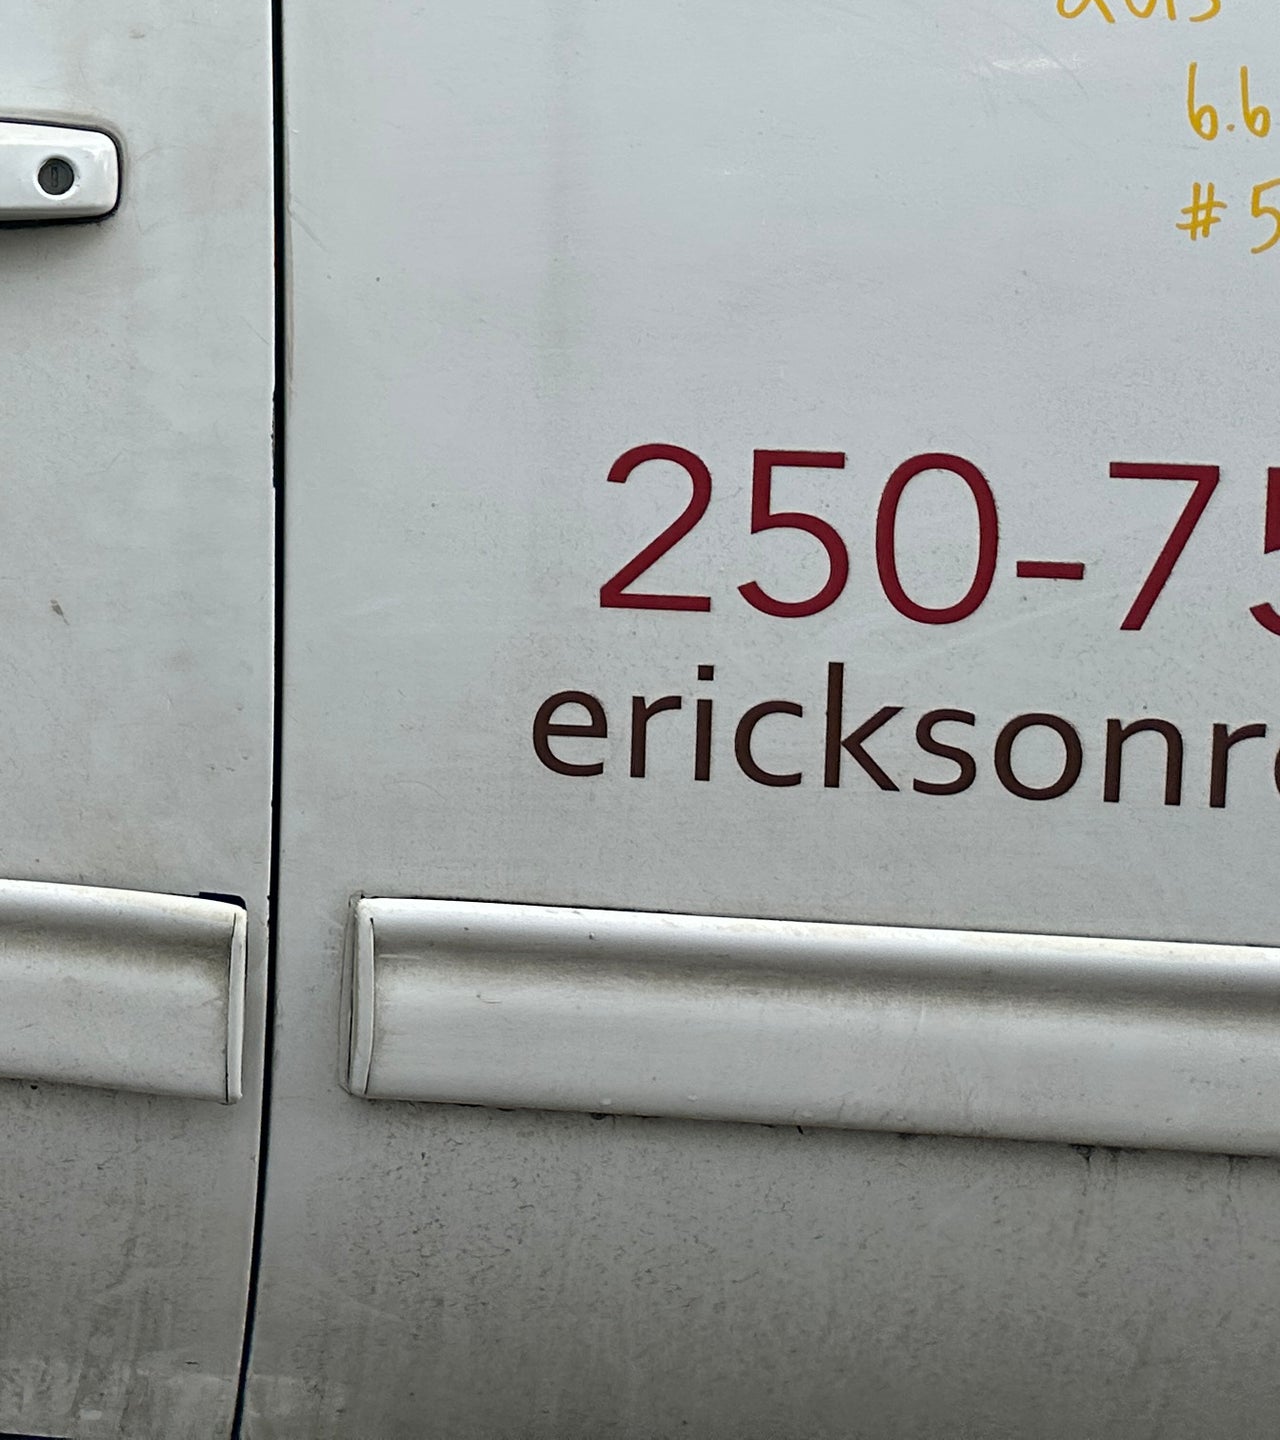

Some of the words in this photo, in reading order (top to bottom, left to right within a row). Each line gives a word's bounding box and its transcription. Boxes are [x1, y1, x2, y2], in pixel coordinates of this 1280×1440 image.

[1187, 62, 1271, 141] 6.6
[599, 443, 1280, 636] 250-7
[532, 661, 1280, 810] ericksonr
